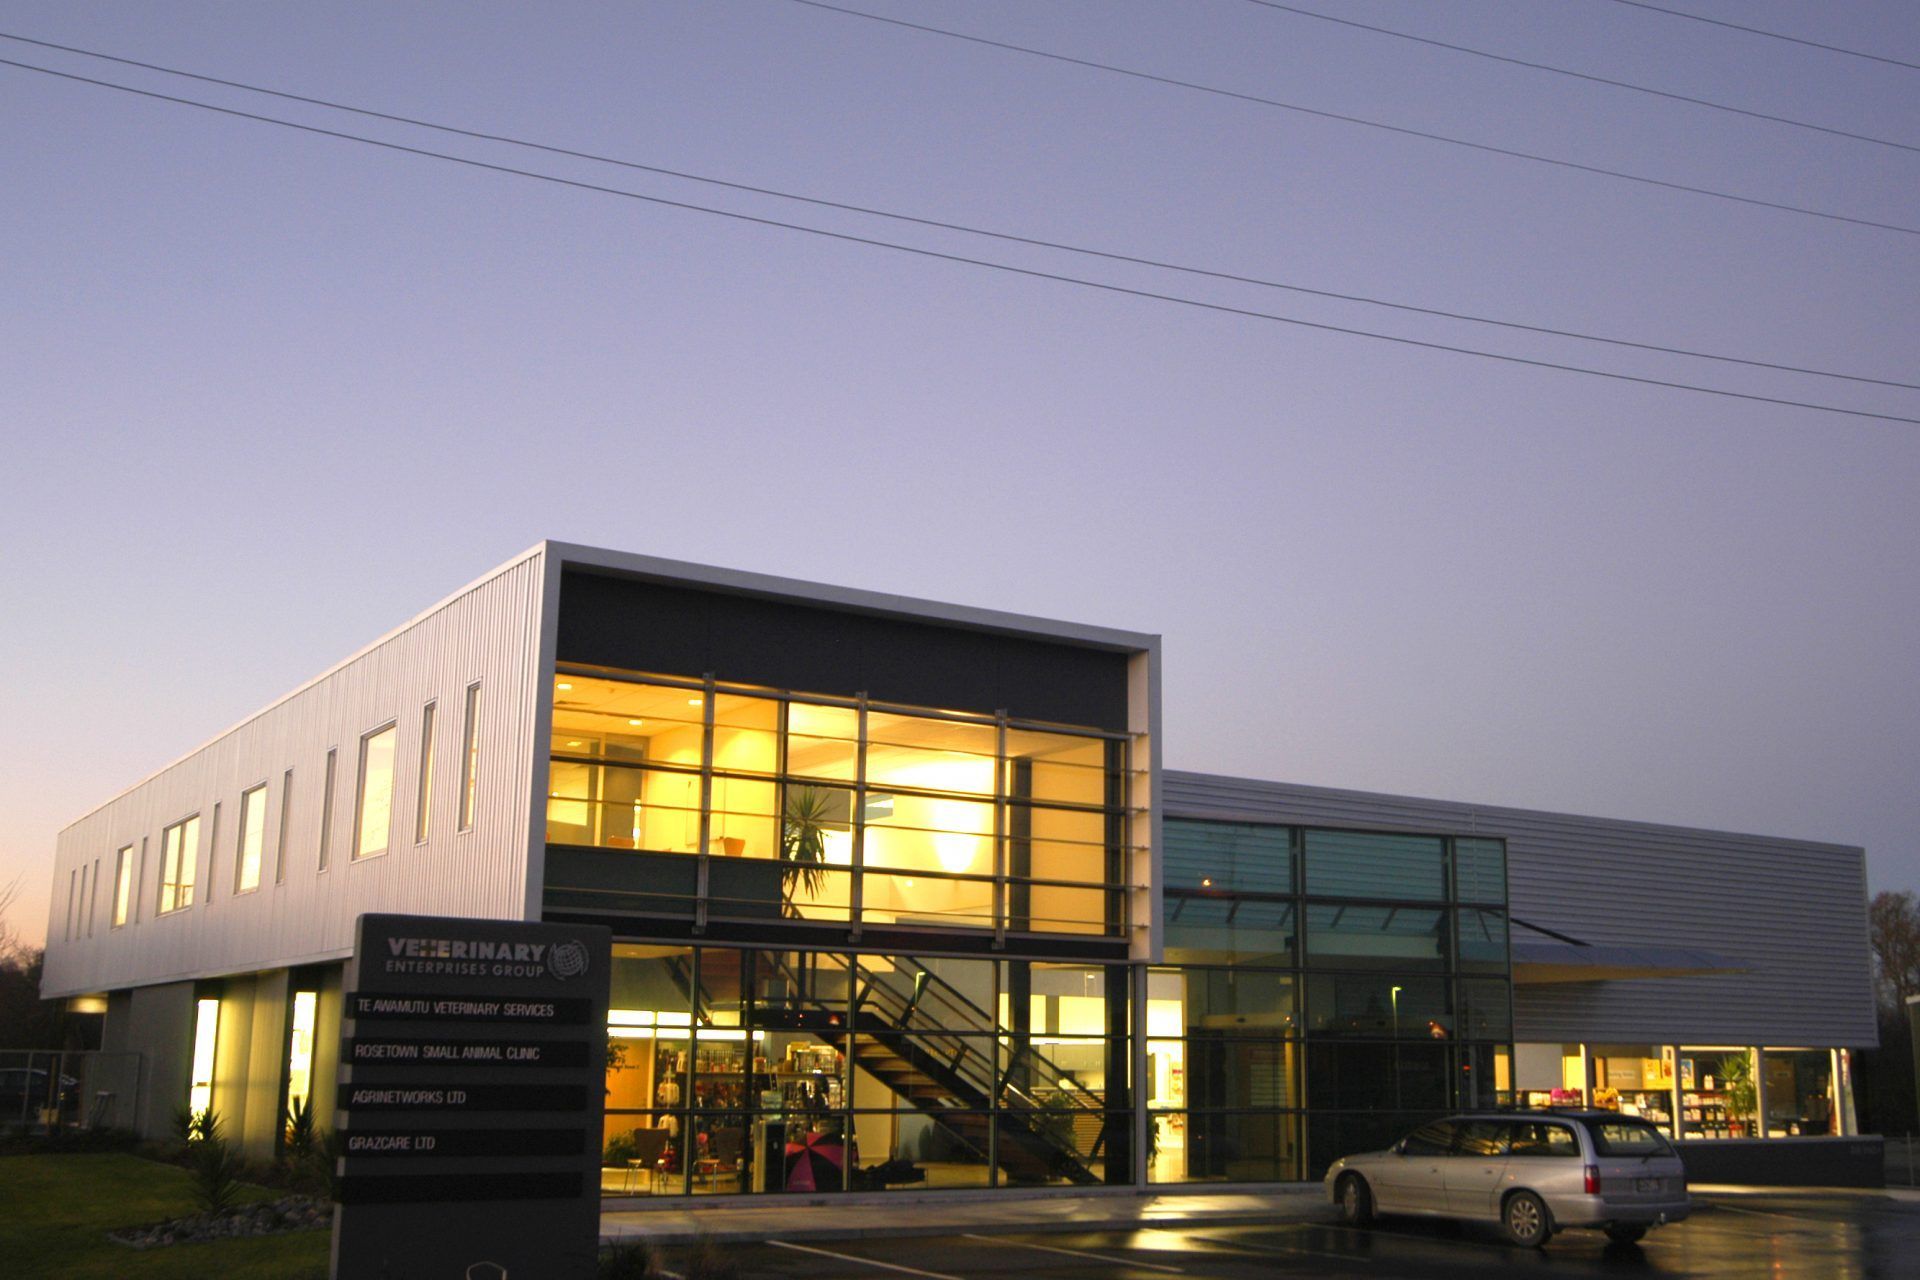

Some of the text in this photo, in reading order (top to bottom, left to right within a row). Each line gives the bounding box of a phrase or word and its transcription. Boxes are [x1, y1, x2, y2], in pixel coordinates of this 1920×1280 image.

[386, 960, 544, 978] ENTERPRISES GROUP
[358, 999, 554, 1017] TE AWAMUTU VETERINARY SERVICES
[355, 1045, 540, 1060] ROSETOWN SMALL ANIMAL CLINIC
[352, 1090, 466, 1104] AGRINETWORKS LTD
[349, 1137, 435, 1150] GRAZCARE LTD
